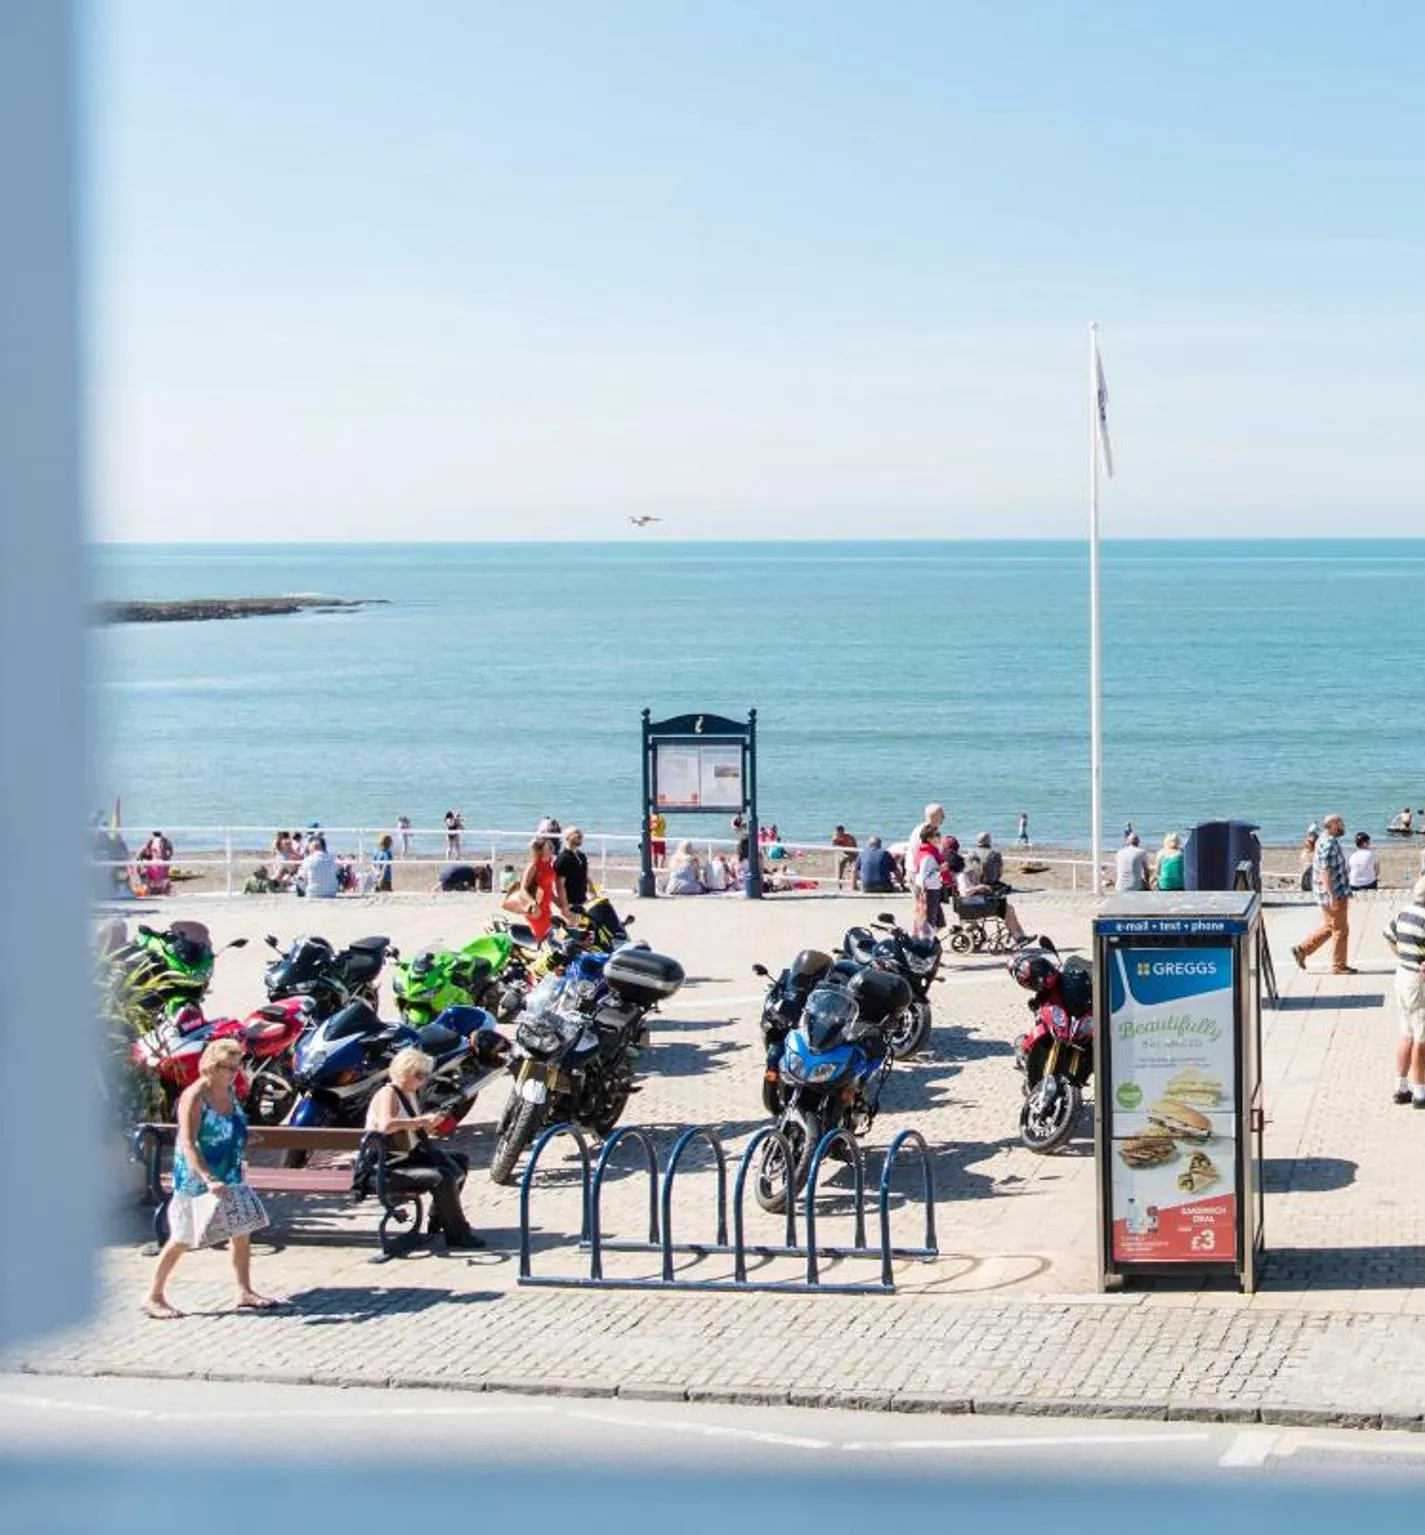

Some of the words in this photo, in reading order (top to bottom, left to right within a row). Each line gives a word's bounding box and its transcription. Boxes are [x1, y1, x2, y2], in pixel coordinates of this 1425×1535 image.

[1115, 920, 1149, 932] e-mail
[1160, 920, 1181, 932] text
[1191, 920, 1225, 932] phone
[1153, 961, 1217, 976] GREGGS
[1118, 1016, 1222, 1041] Beautifully
[1191, 1229, 1216, 1250] £3
